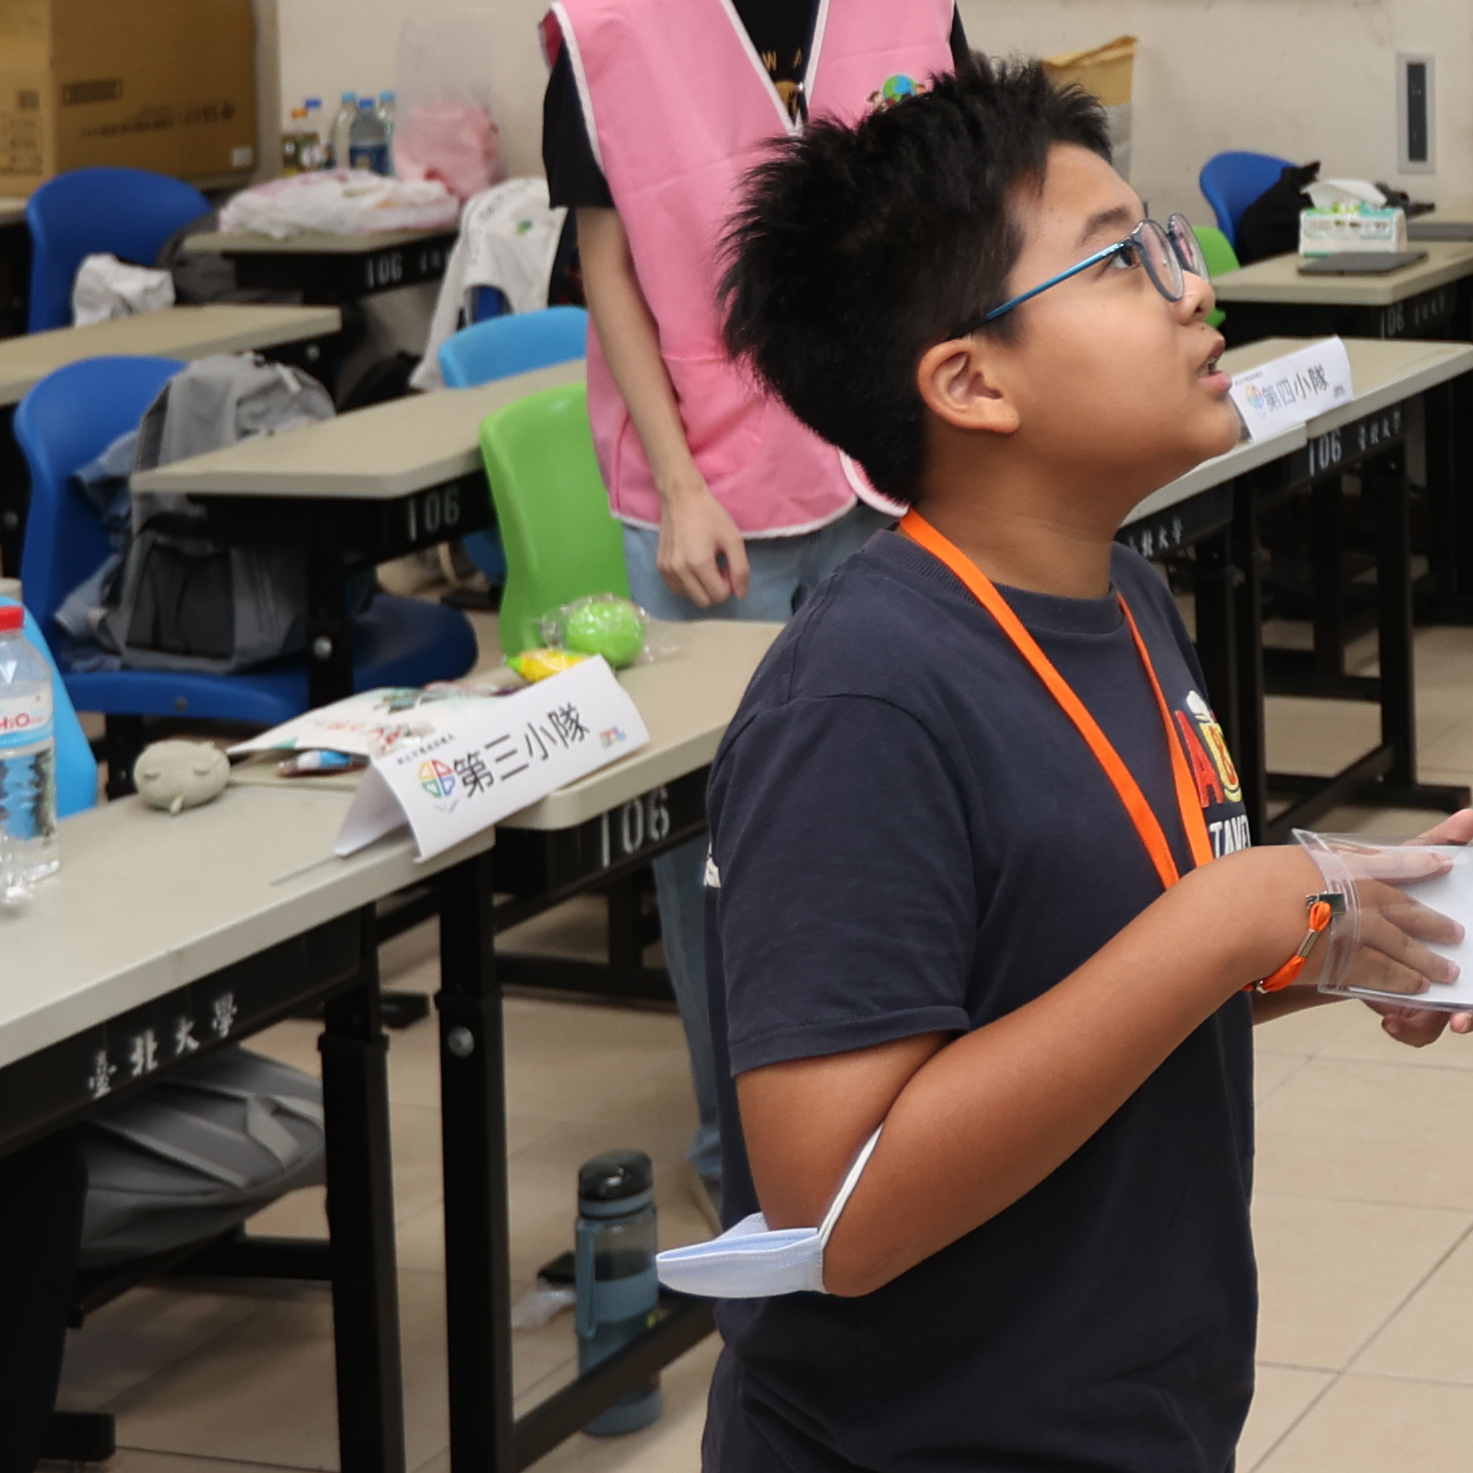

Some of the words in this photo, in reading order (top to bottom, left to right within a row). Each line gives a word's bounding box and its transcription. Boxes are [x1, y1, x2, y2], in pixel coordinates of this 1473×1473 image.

[1261, 363, 1330, 413] 第四小隊
[1308, 428, 1342, 477] 106
[407, 484, 461, 542] 106
[453, 701, 592, 799] 第三小隊
[601, 785, 671, 868] 106
[88, 992, 237, 1100] 臺北大學
